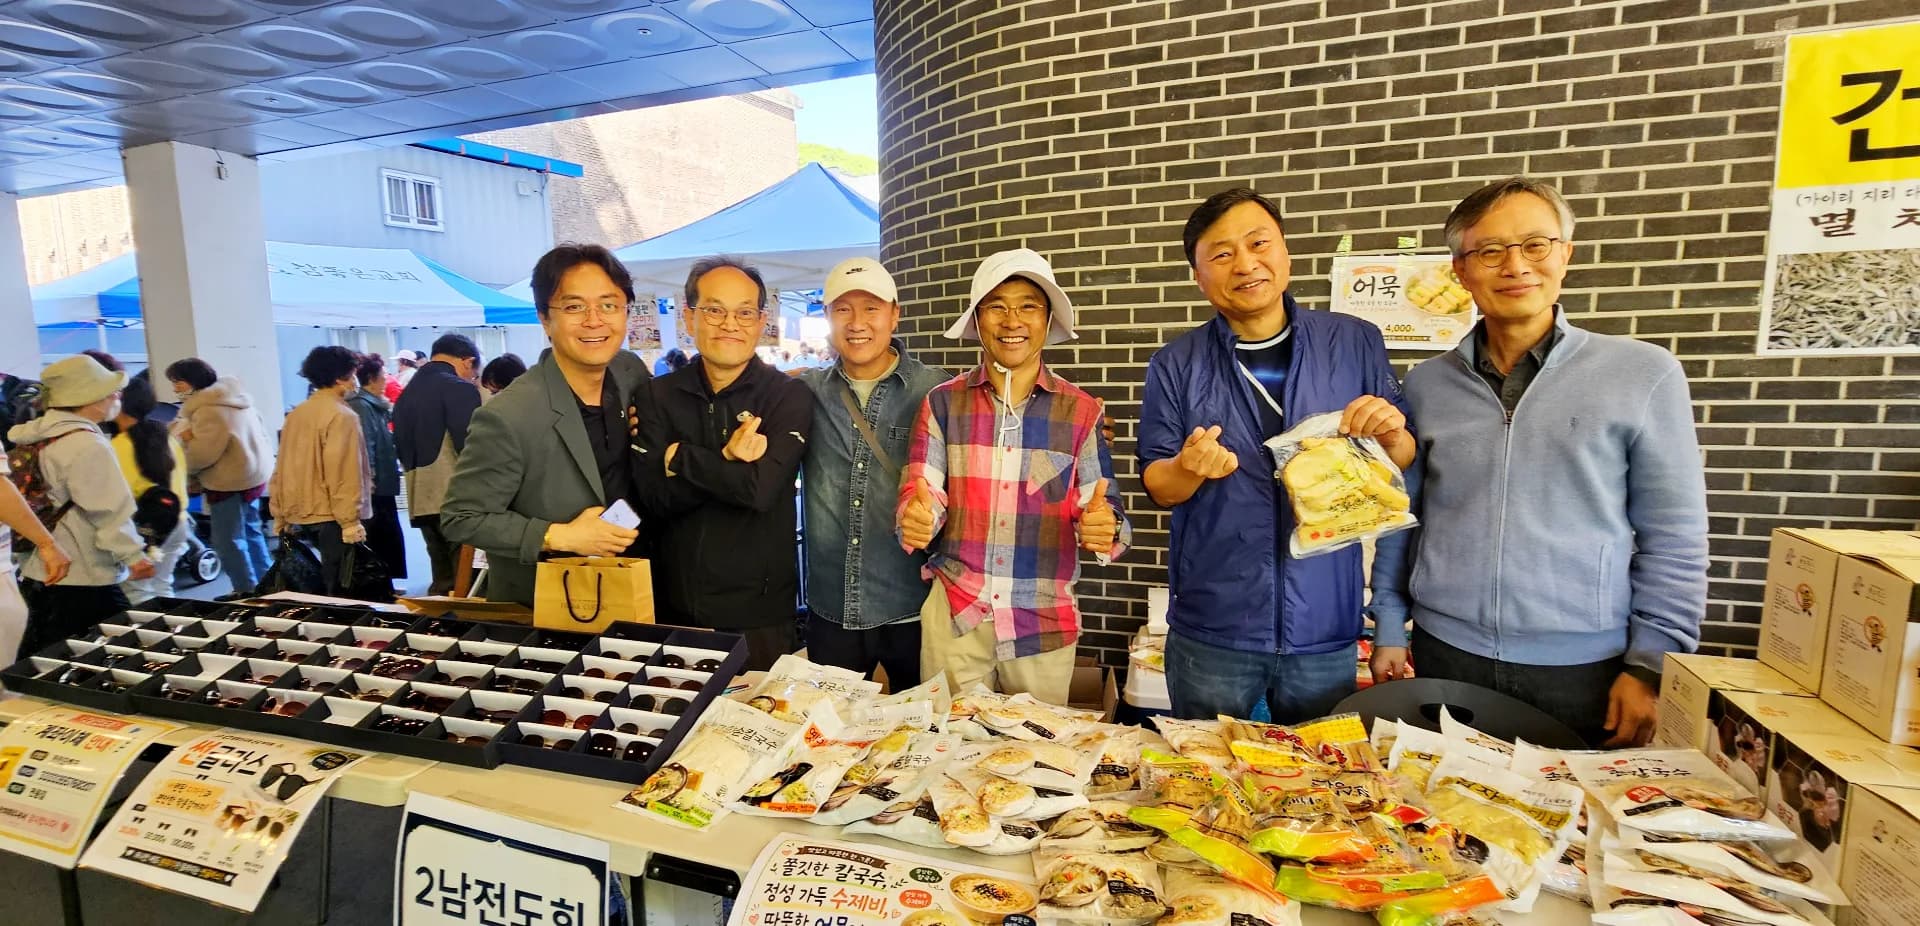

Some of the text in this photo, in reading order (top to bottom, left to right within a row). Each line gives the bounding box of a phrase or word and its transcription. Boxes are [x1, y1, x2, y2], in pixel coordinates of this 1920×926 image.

[1862, 186, 1896, 202] 지리
[1808, 207, 1857, 238] 멸
[1353, 275, 1401, 298] 어묵
[782, 857, 888, 890] 쫄깃한 칼국수,
[764, 883, 888, 919] 정성 가득 수제비,
